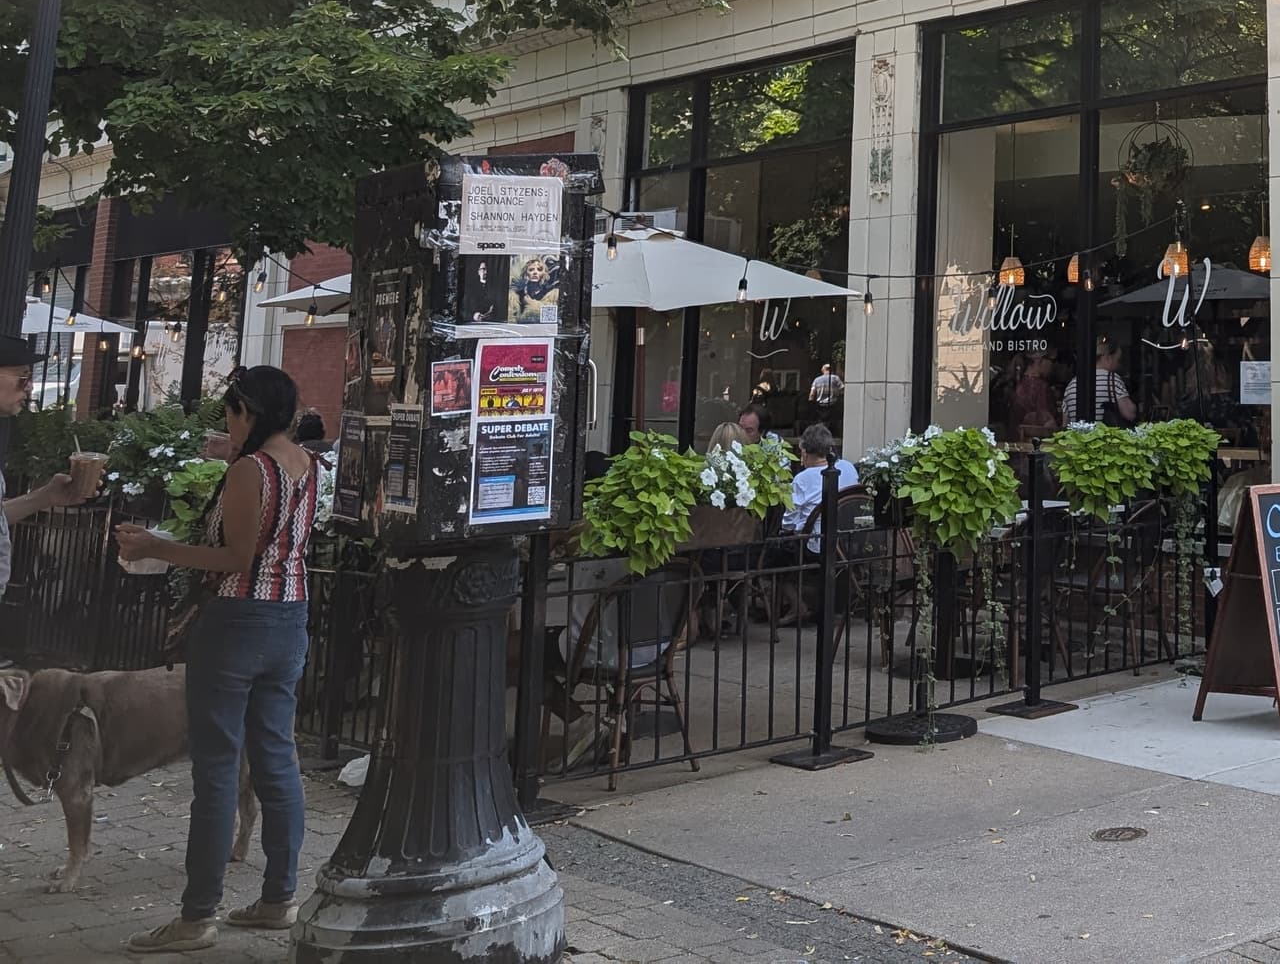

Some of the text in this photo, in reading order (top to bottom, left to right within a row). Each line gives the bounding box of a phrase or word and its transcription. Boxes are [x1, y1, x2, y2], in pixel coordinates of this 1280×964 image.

[469, 187, 549, 197] JOEL STYZENS:
[467, 196, 525, 206] RESONANCE
[470, 212, 559, 222] SHANNON HAYDEN
[477, 242, 505, 251] space
[948, 283, 1057, 336] Willow
[1008, 339, 1047, 351] BISTRO
[481, 423, 549, 434] SUPER DEBATE
